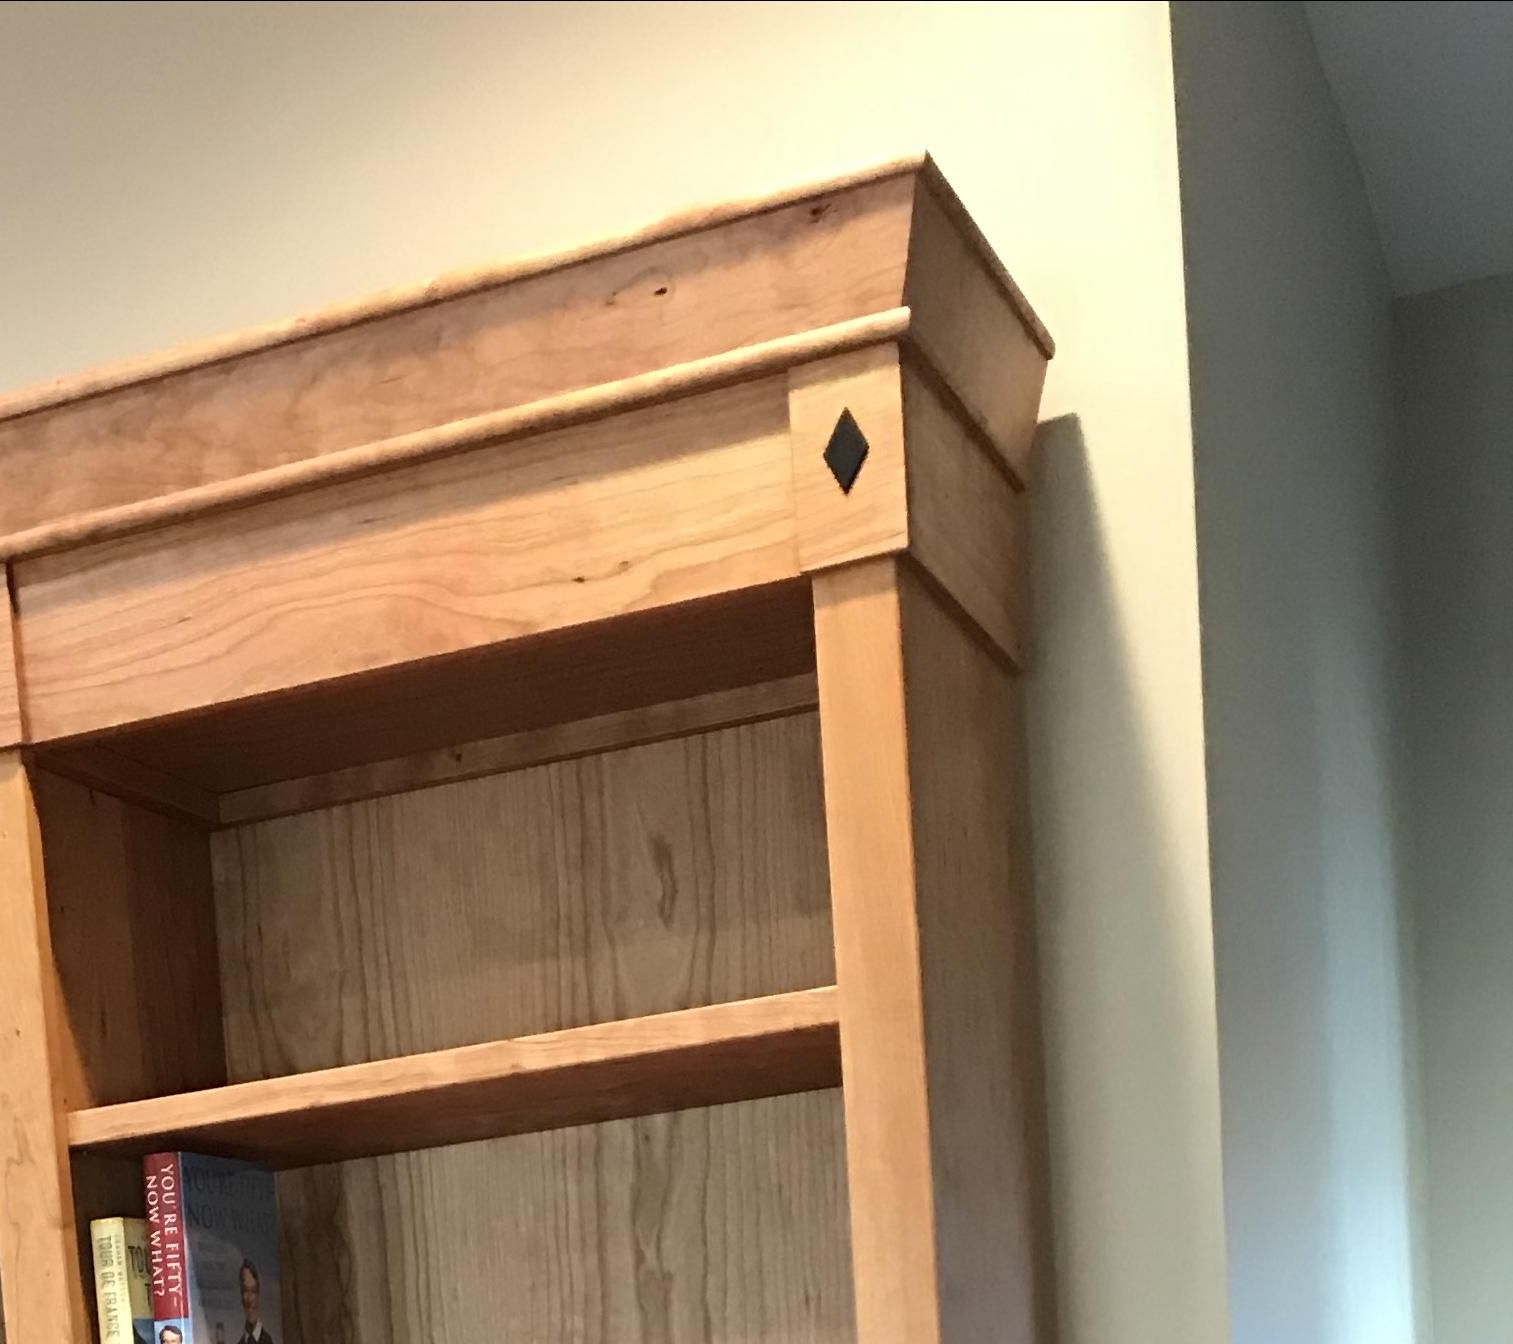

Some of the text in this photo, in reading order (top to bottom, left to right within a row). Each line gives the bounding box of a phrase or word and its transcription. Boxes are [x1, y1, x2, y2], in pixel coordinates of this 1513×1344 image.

[160, 1163, 178, 1236] YOU'RE
[99, 1235, 114, 1266] TOUR
[146, 1176, 165, 1297] NOW WHAT?
[101, 1271, 116, 1290] DE
[103, 1291, 121, 1340] FRANCE
